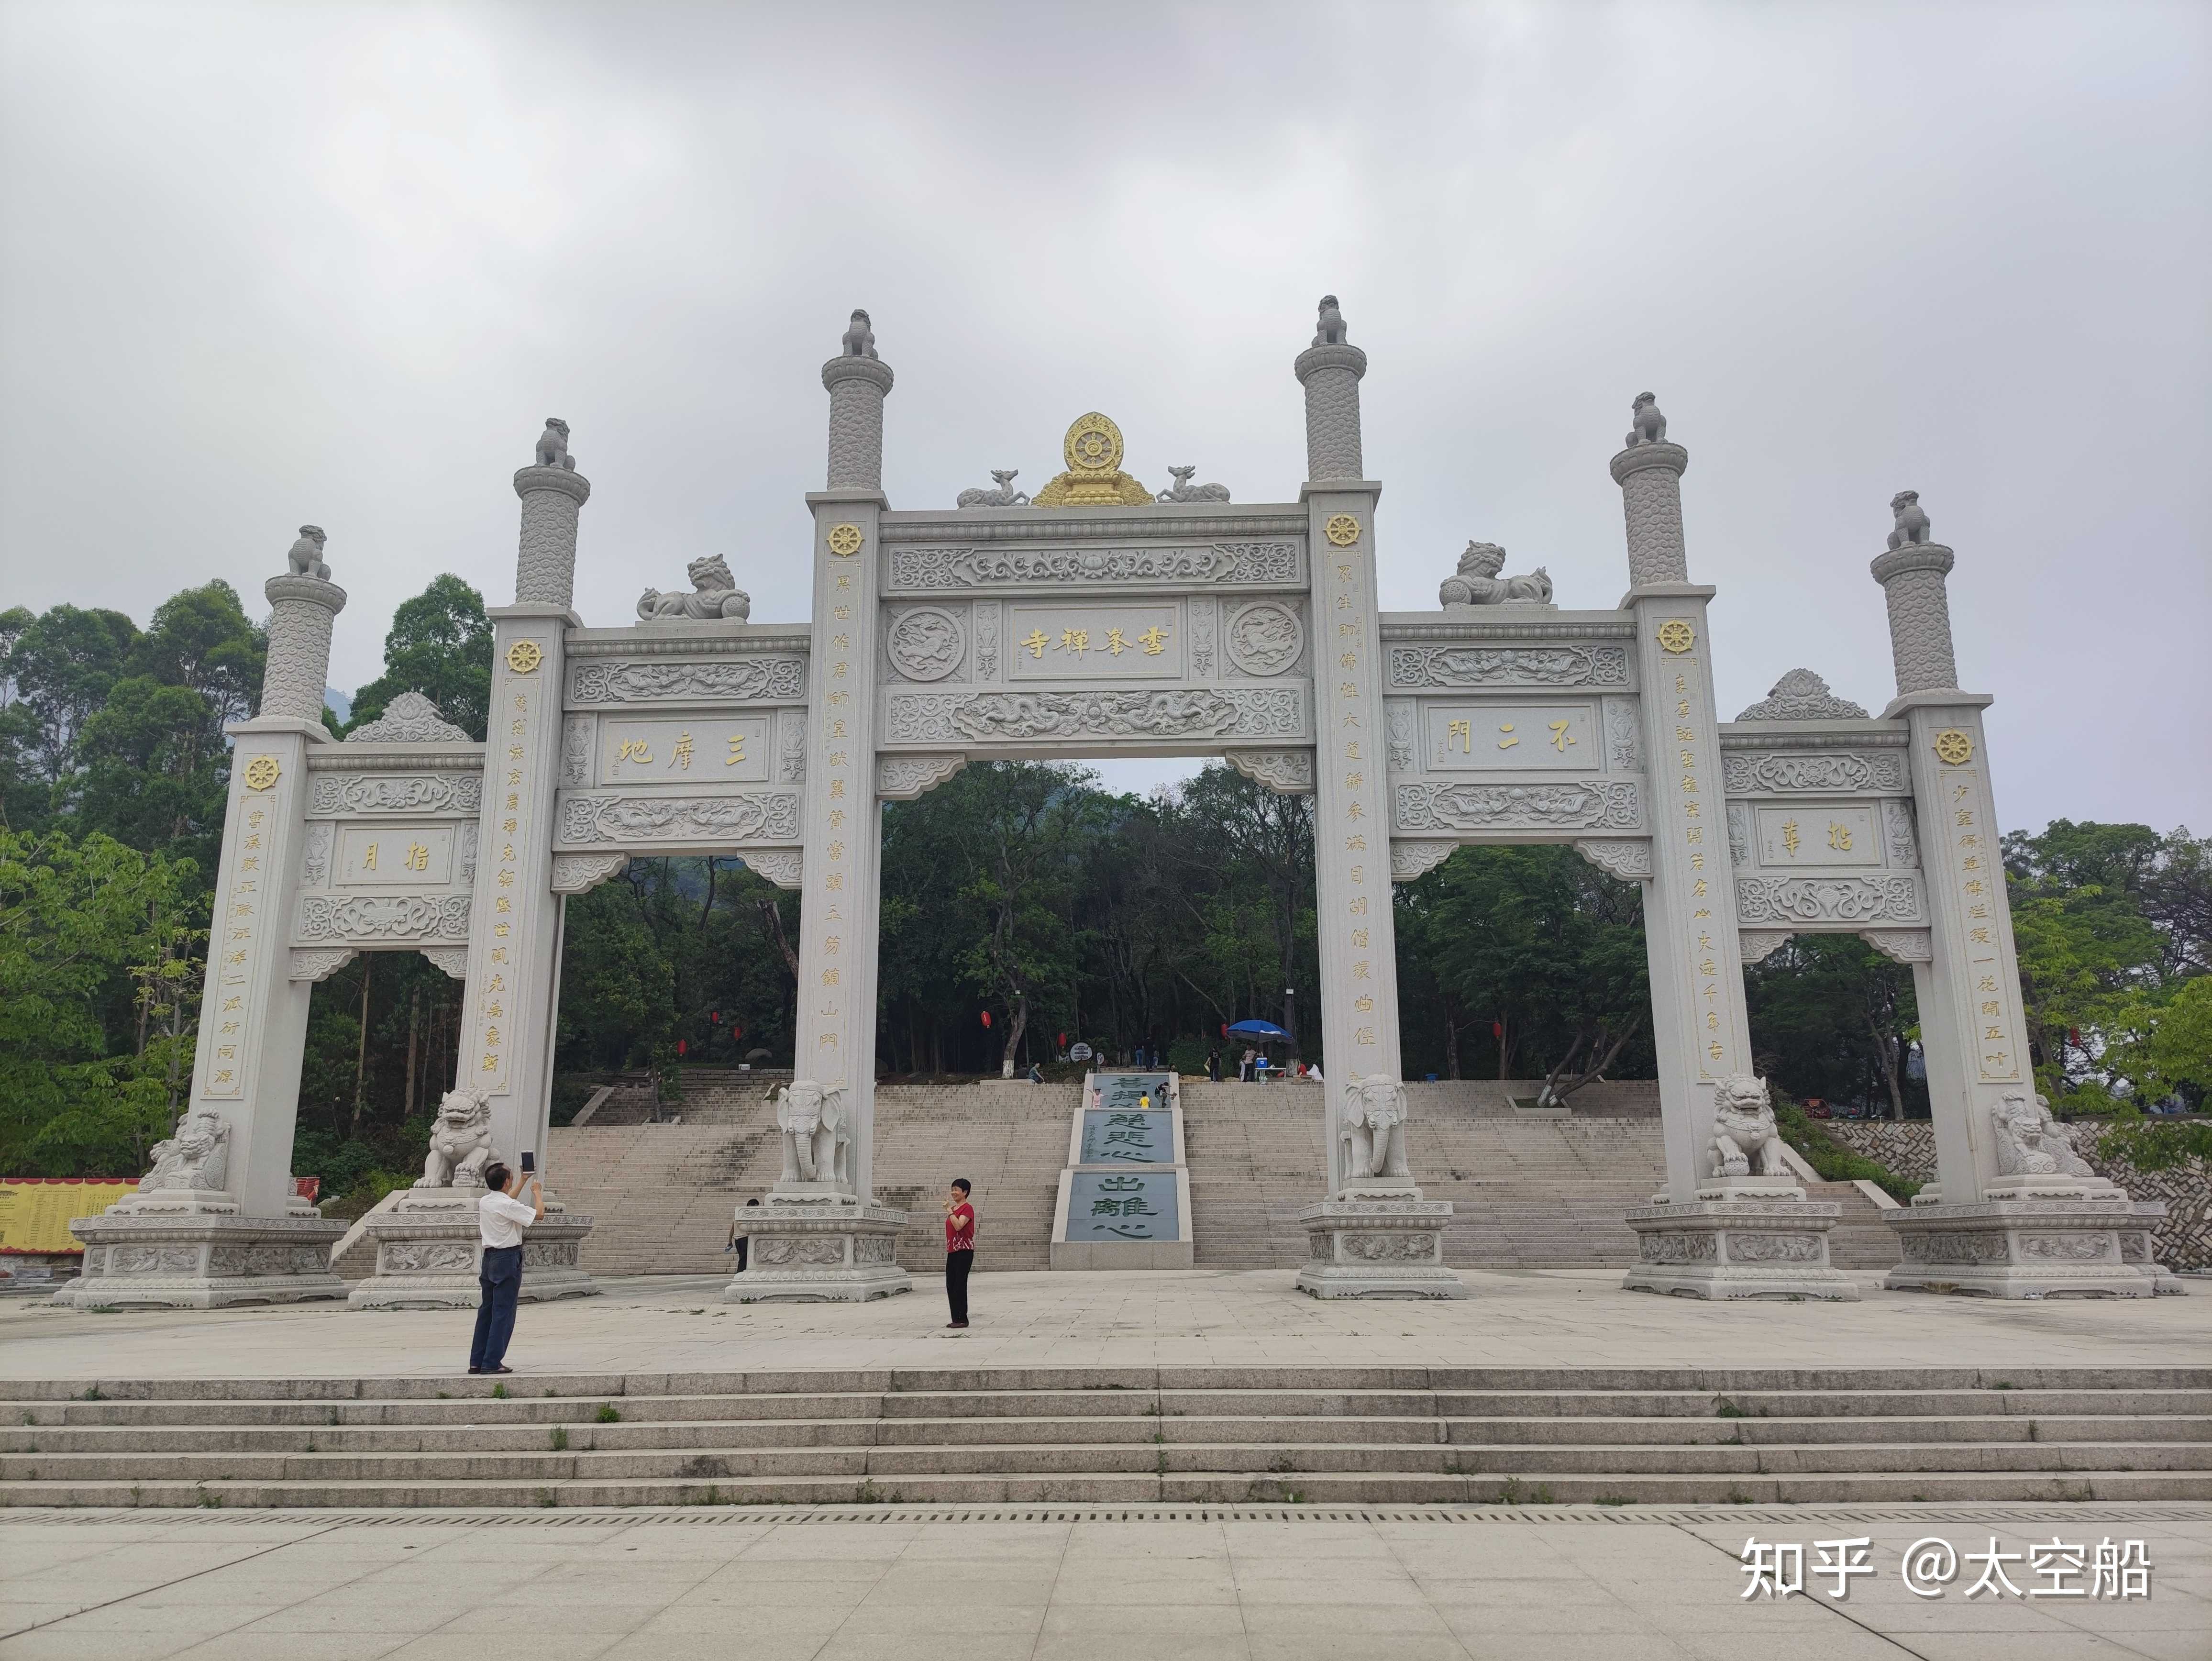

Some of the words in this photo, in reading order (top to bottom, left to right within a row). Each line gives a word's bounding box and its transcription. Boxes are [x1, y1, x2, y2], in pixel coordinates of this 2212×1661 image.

[620, 730, 747, 770] 三摩地
[1448, 719, 1577, 753] 不二門
[363, 842, 429, 871] 指月
[1100, 1113, 1156, 1163] 慈悲心
[1091, 1176, 1159, 1240] 出離心
